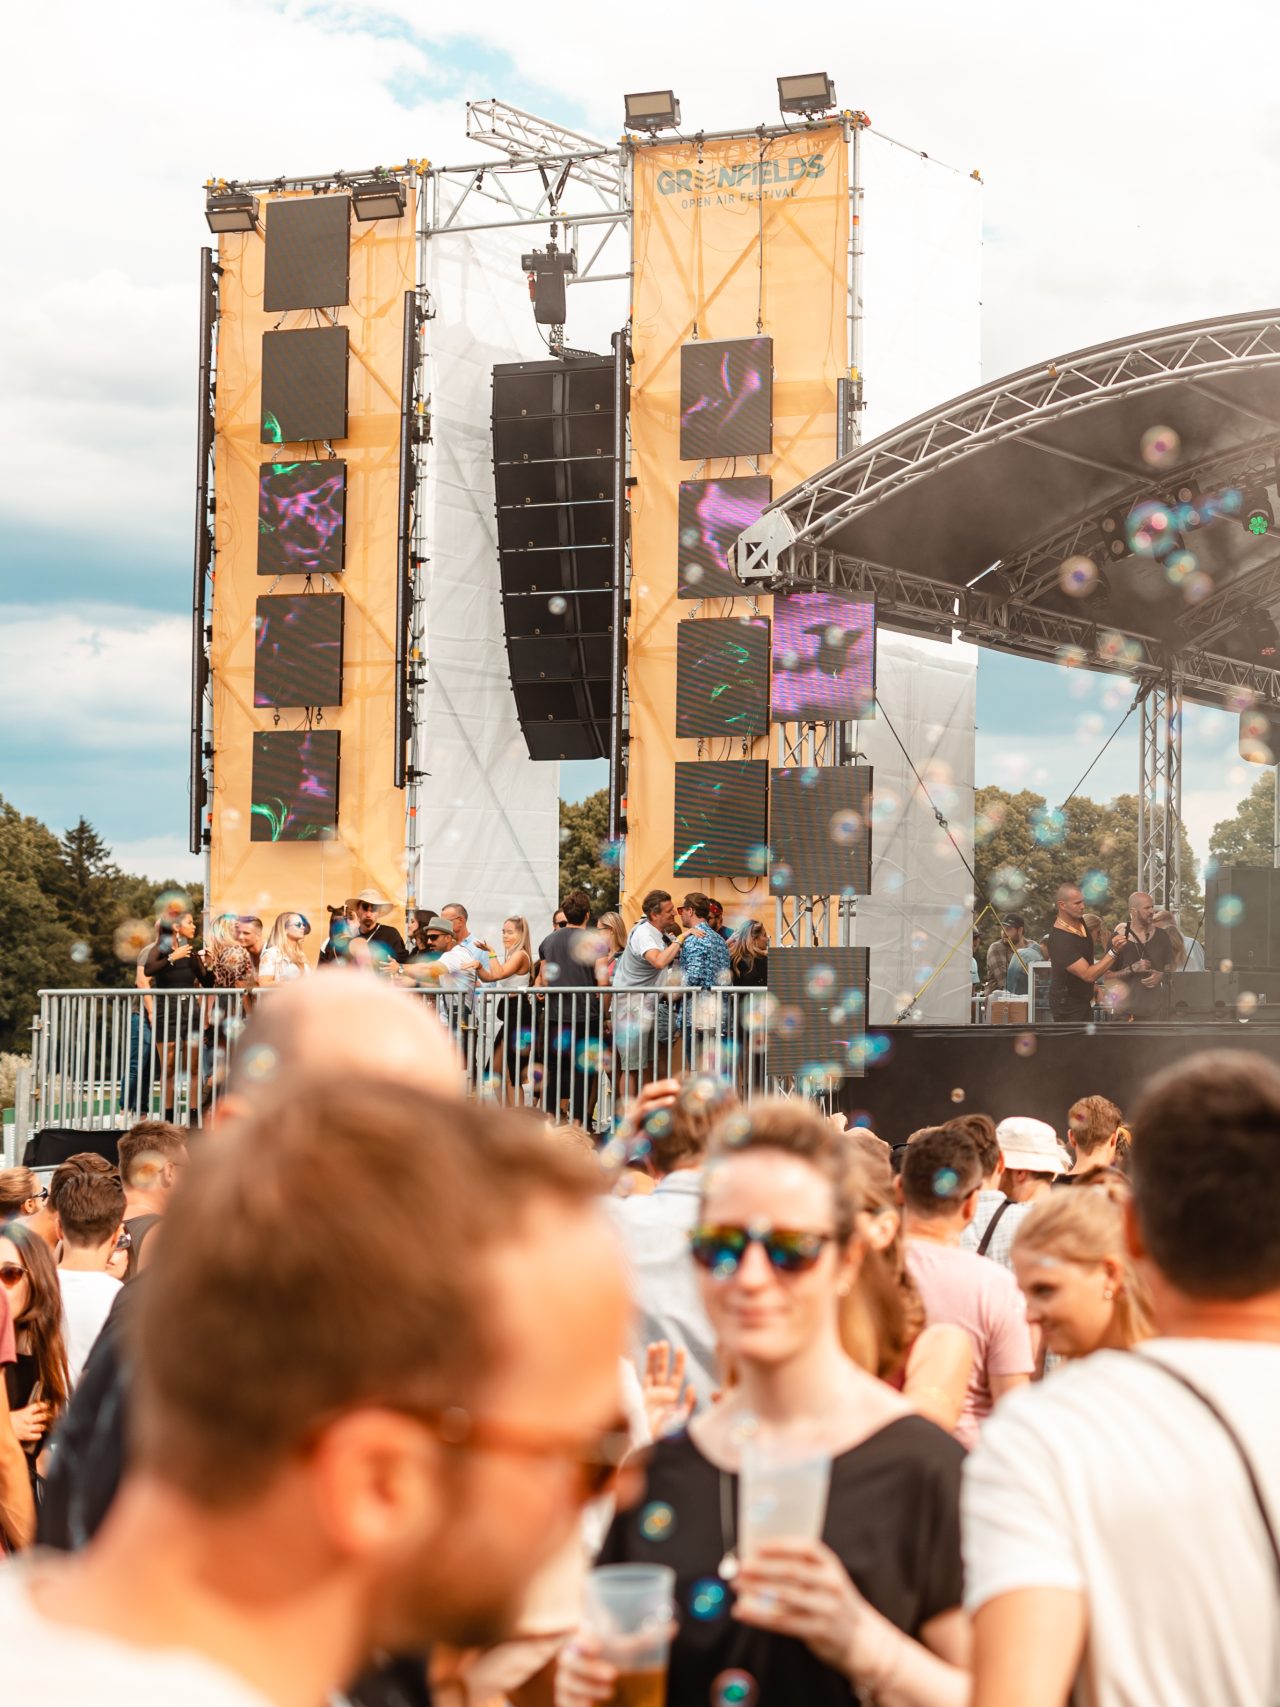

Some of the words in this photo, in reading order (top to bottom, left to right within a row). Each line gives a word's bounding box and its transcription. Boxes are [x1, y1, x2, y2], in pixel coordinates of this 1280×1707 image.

[681, 196, 711, 209] OPEN
[717, 194, 735, 205] AIR
[740, 188, 797, 201] FESTIVAL
